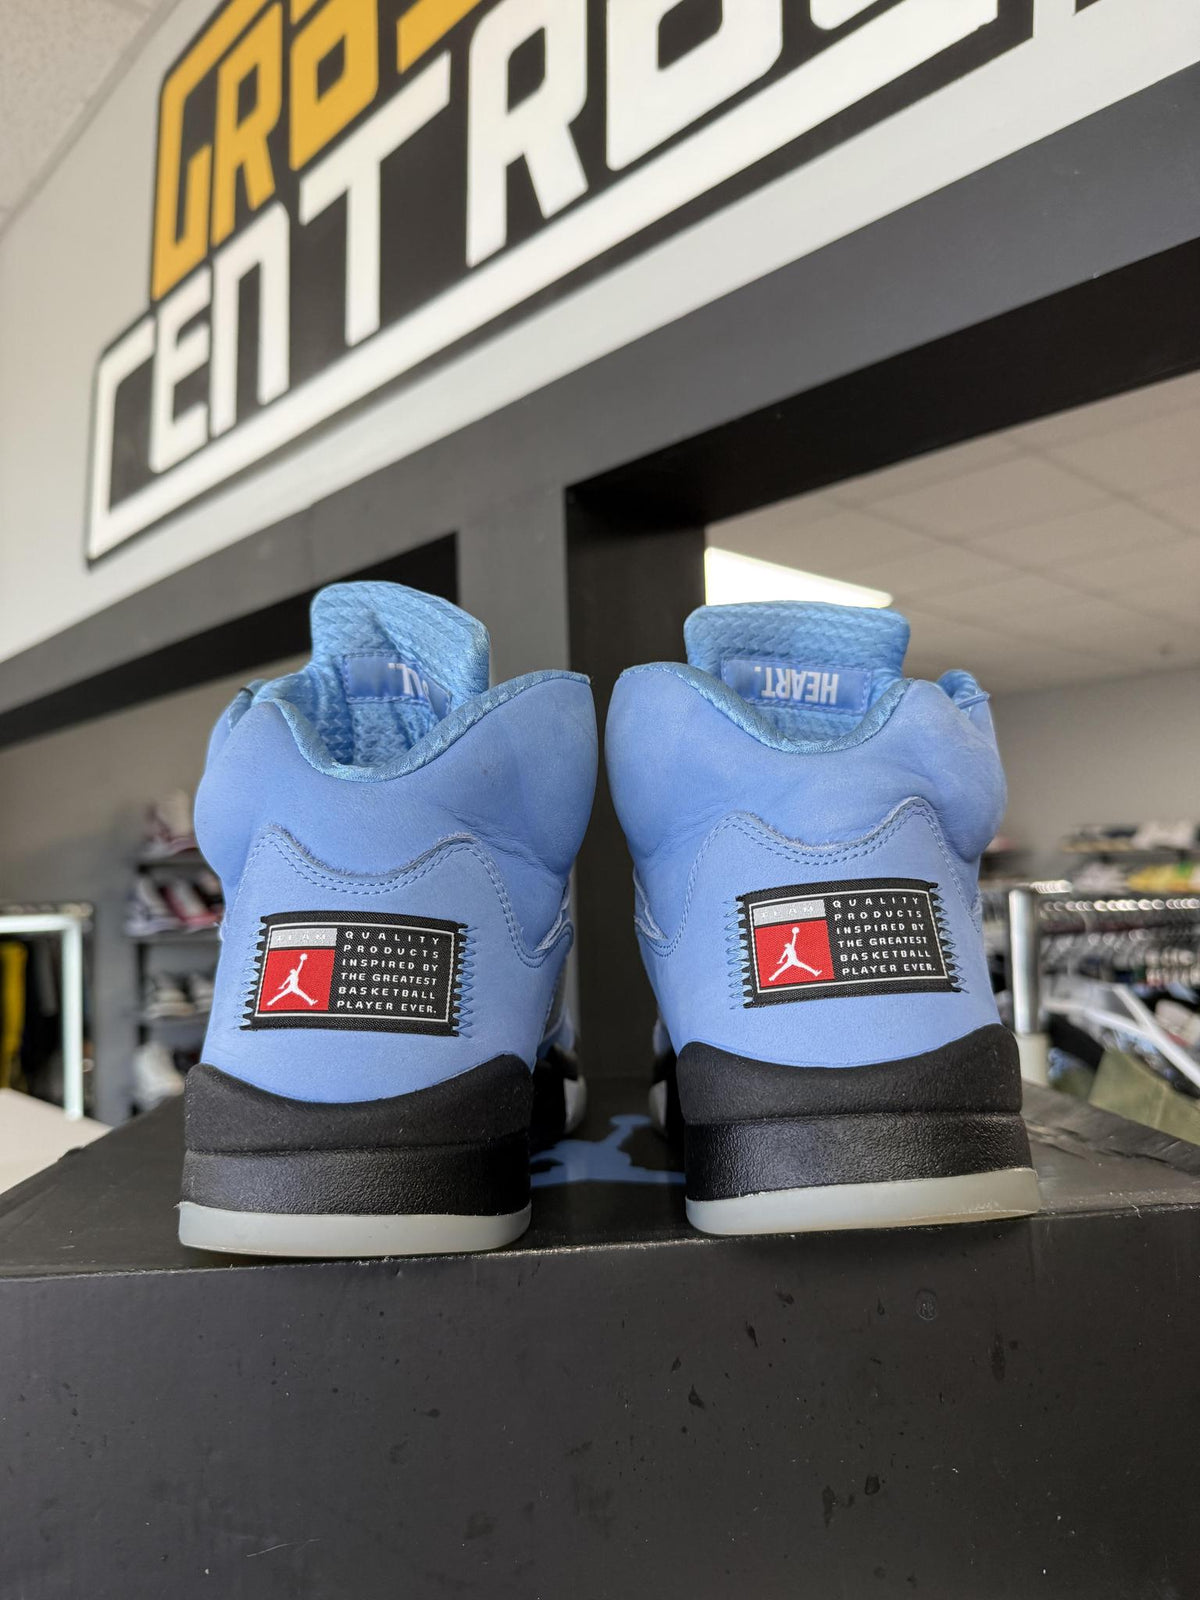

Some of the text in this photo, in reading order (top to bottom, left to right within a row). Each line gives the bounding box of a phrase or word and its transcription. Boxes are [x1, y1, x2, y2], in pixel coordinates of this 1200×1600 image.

[754, 666, 840, 705] HEART.
[832, 897, 918, 908] QUALITY
[834, 910, 922, 921] PRODUCTS
[836, 923, 925, 935] INSPIRED BY
[345, 931, 439, 945] QUALITY
[838, 936, 927, 948] THE GREATEST
[343, 944, 439, 959] PRODUCTS
[840, 950, 931, 962] BASKETBALL
[342, 959, 438, 972] INSPIRED BY
[842, 963, 936, 975] PLAYER EVER.
[340, 972, 437, 985] THE GREATEST
[338, 986, 435, 1000] BASKETBALL
[336, 1000, 437, 1014] PLAYER EVER.
